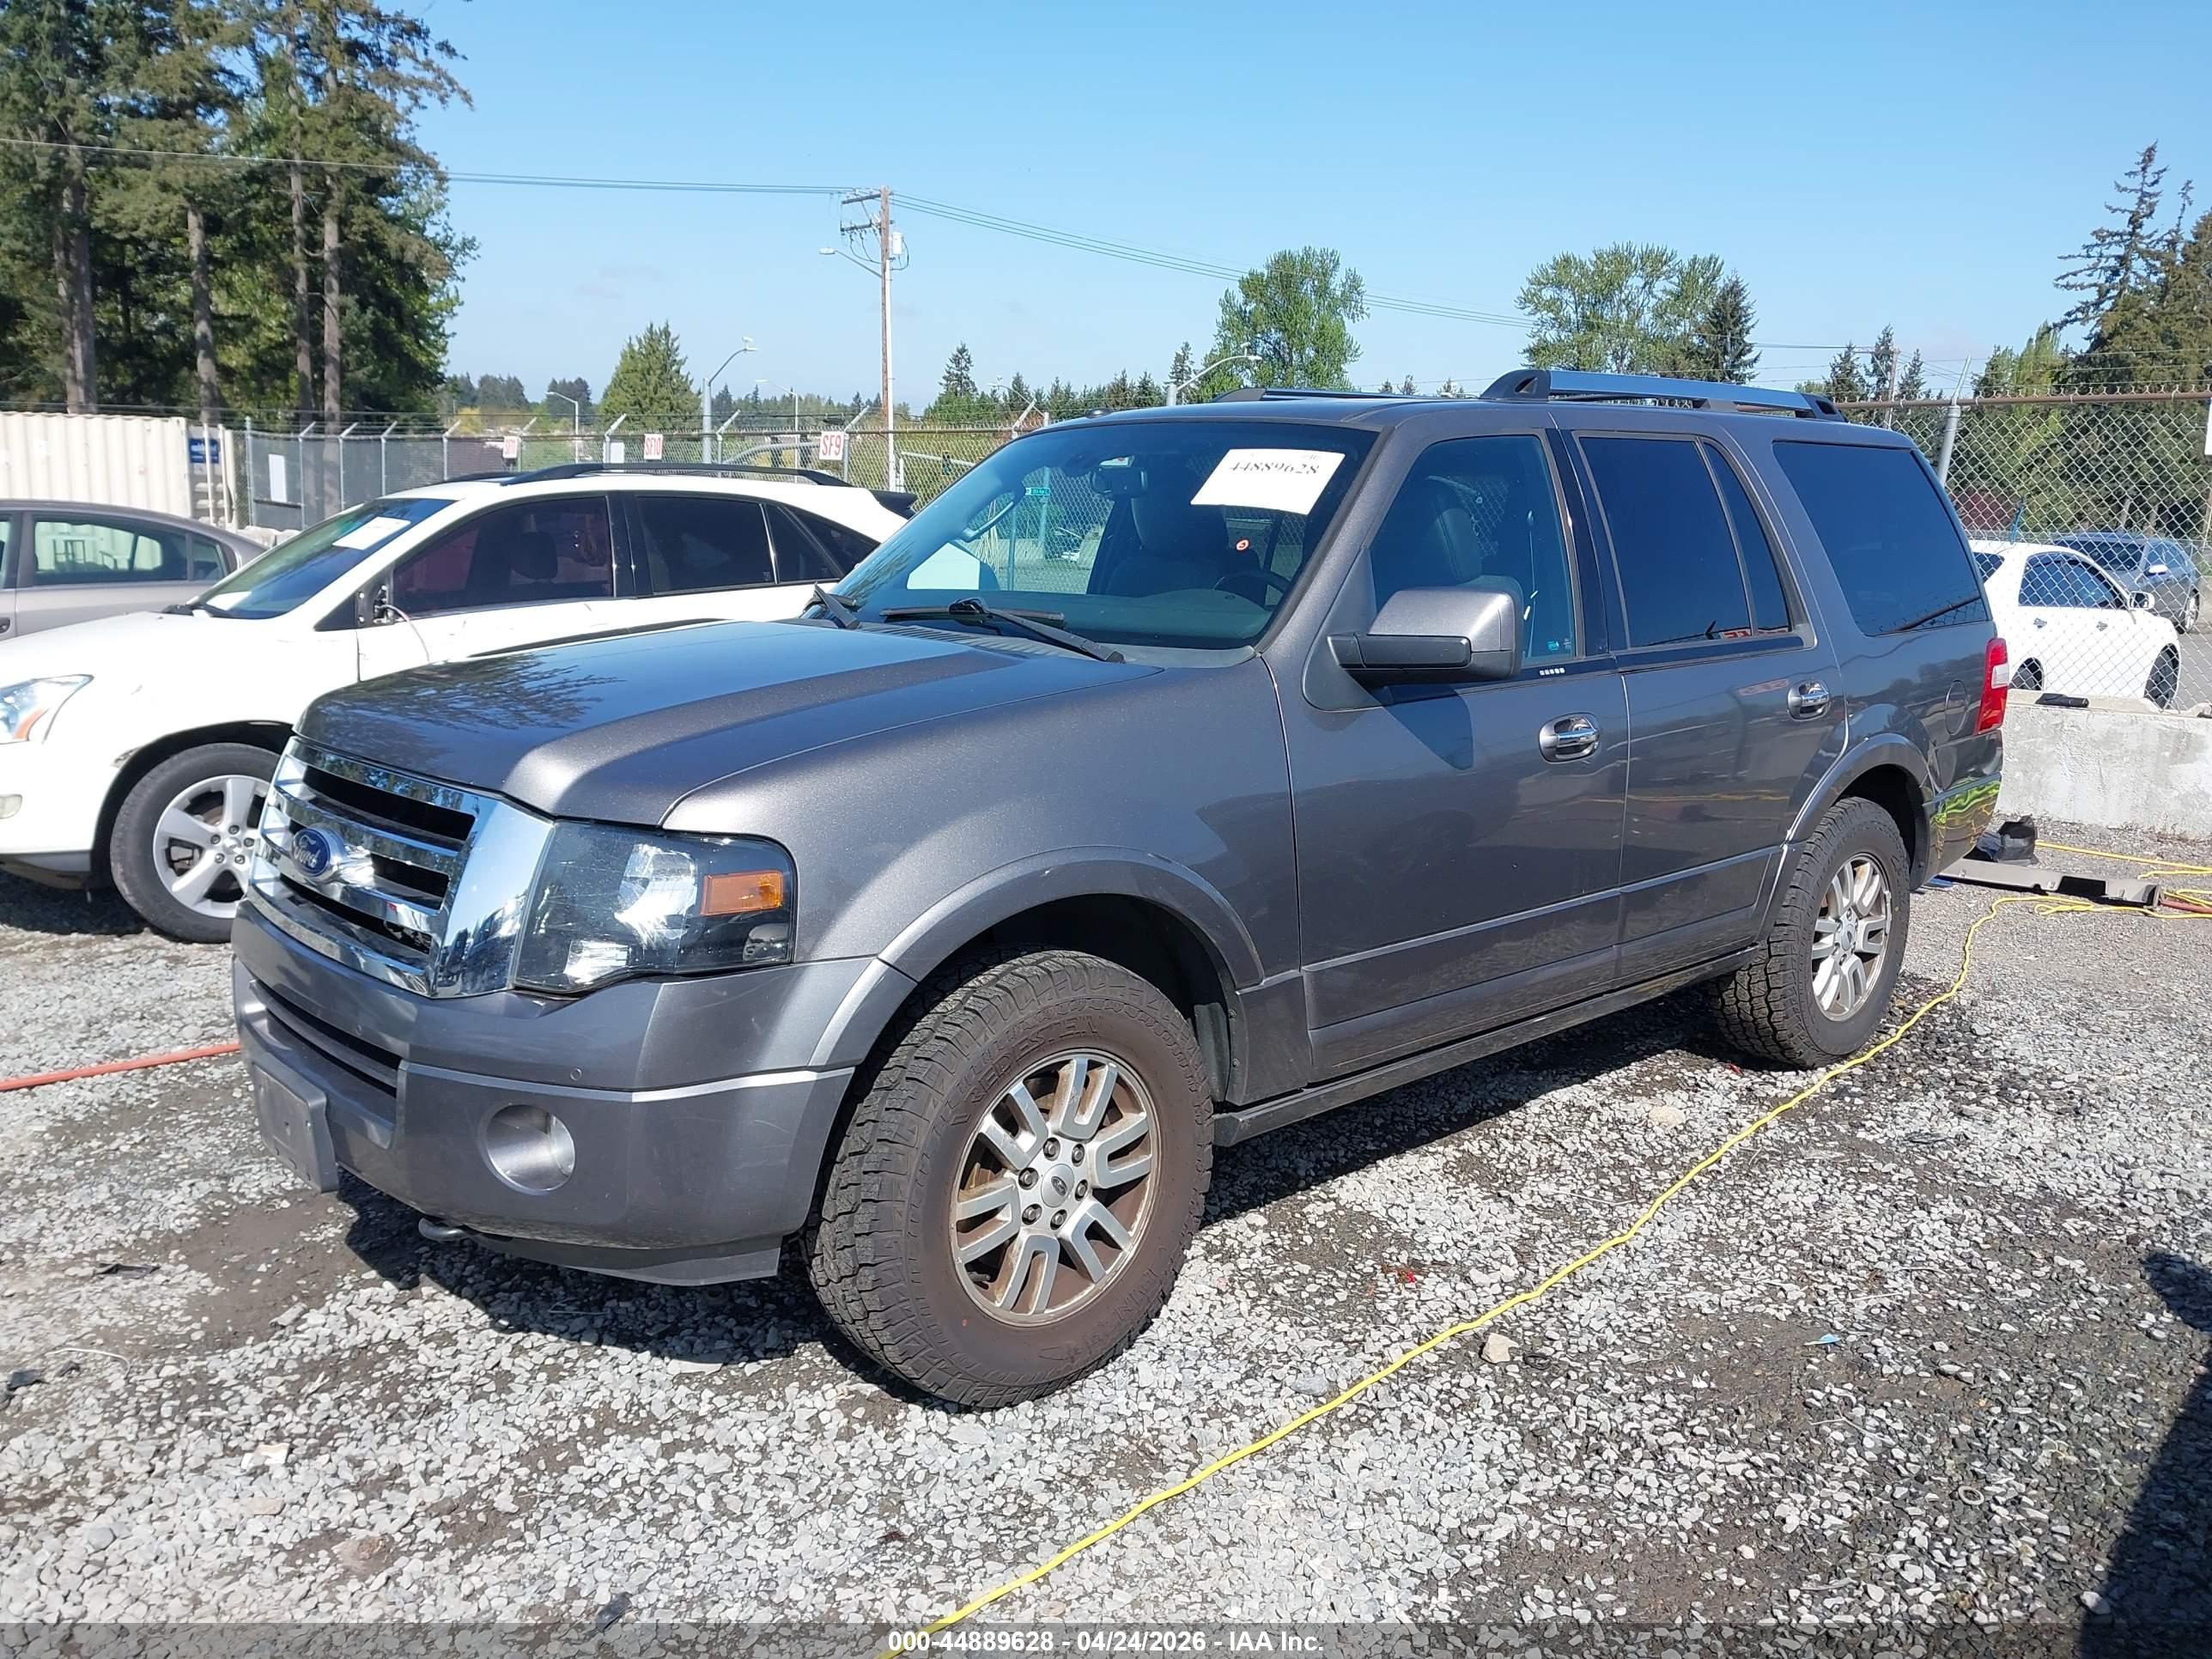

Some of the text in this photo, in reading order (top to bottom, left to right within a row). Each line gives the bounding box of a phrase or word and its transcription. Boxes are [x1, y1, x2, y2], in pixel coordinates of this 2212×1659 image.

[645, 437, 661, 455] SF10
[822, 434, 842, 456] SF9
[1229, 461, 1320, 475] 44889628
[294, 834, 321, 869] Ford
